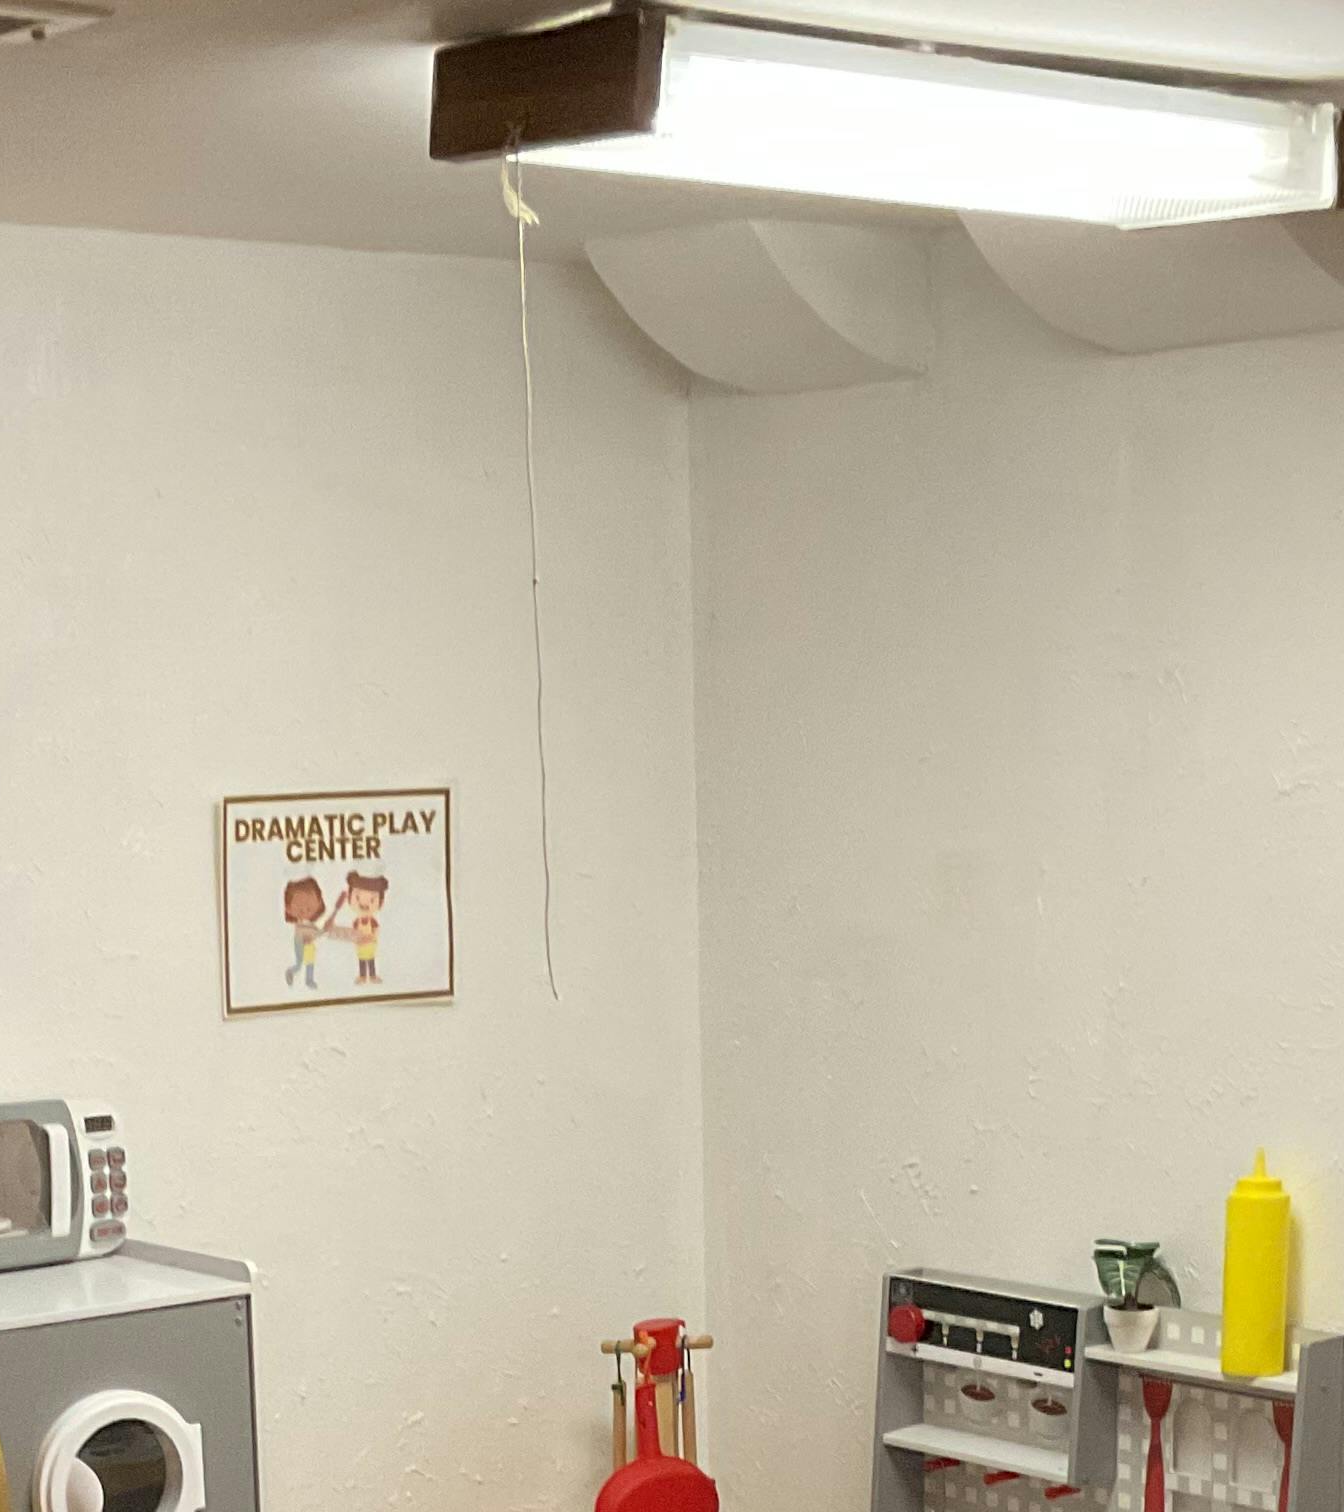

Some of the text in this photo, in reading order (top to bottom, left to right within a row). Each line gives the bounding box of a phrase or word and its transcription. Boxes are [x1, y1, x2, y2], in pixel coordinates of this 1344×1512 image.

[234, 809, 436, 843] DRAMATIC PLAY
[286, 836, 381, 863] CENTER
